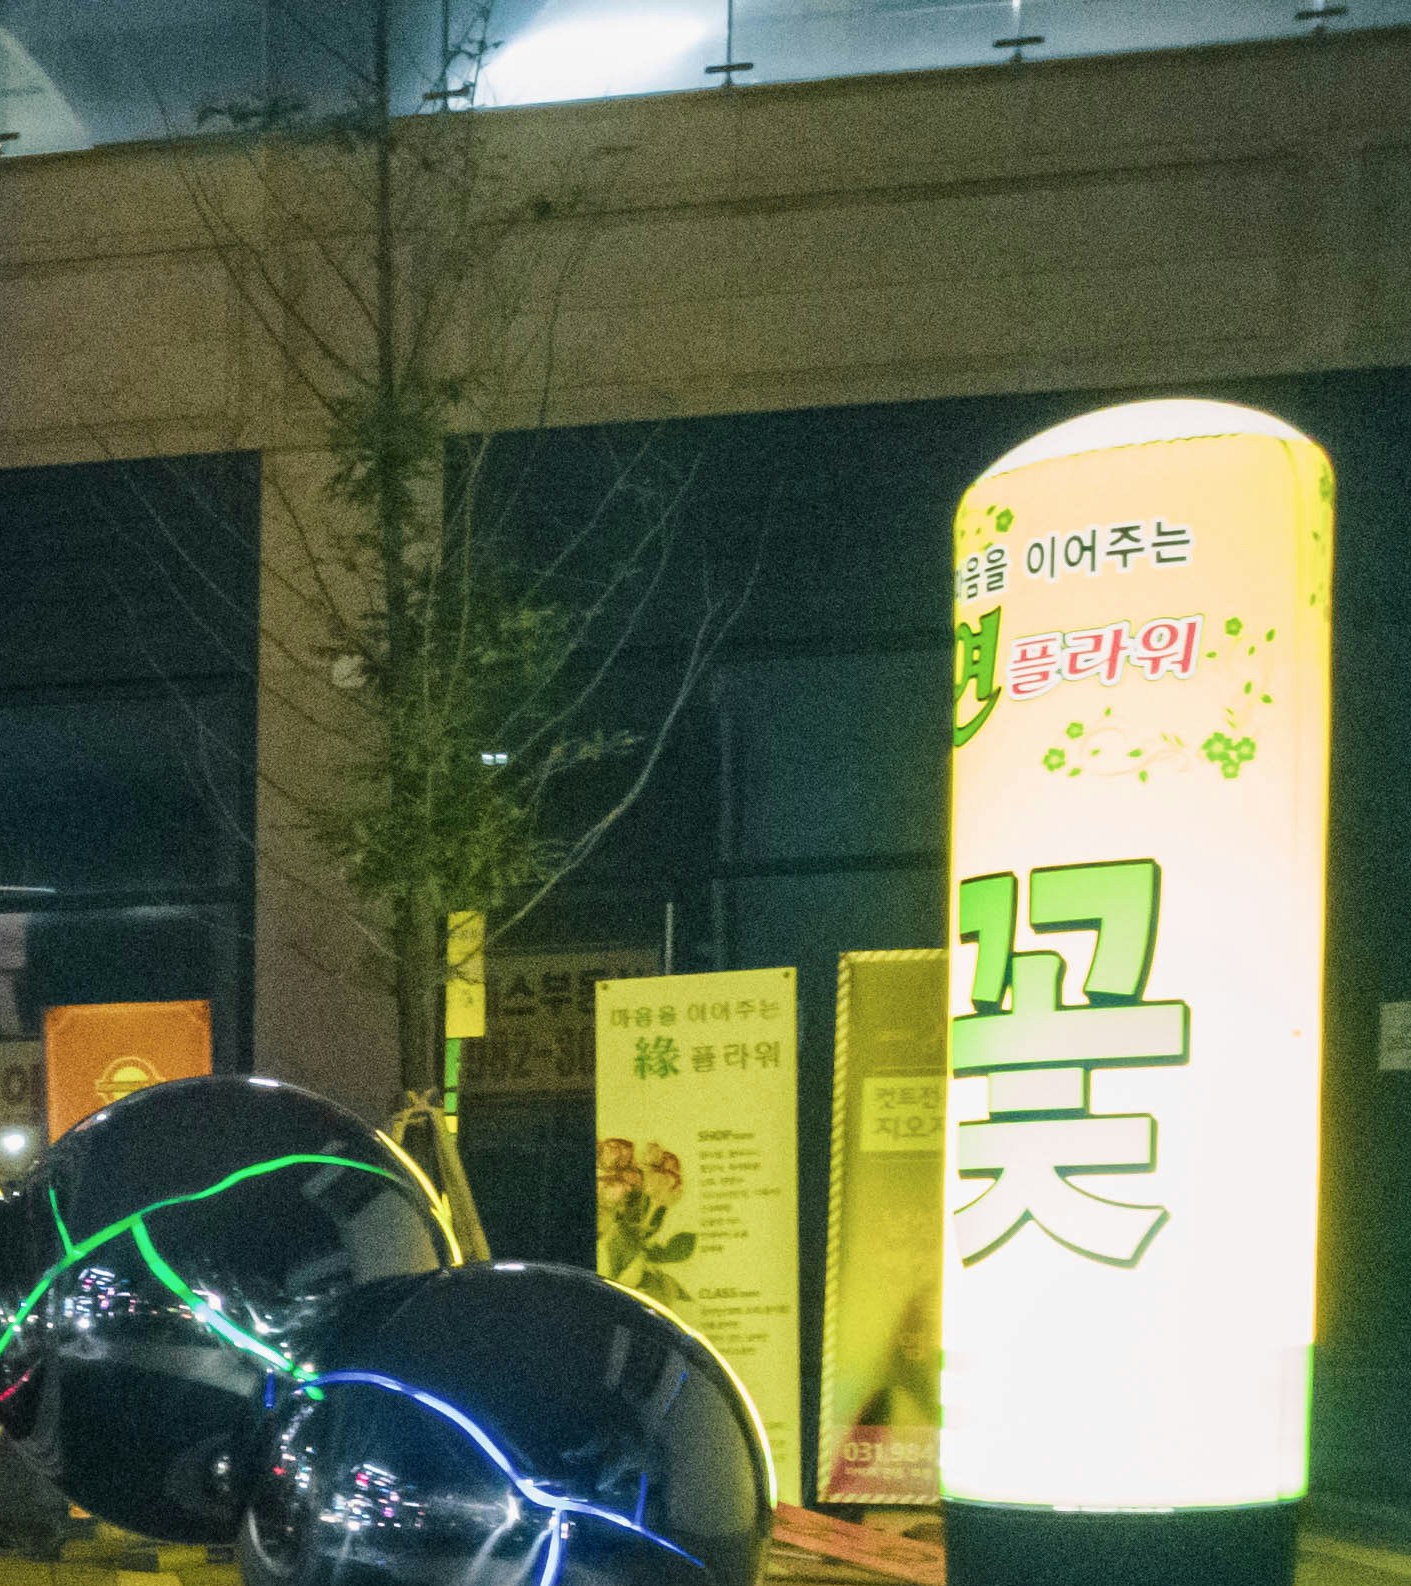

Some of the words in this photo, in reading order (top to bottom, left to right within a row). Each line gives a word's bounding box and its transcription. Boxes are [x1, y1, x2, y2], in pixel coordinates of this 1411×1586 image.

[956, 546, 1008, 600] 음을
[1026, 521, 1191, 579] 이어주는
[1011, 616, 1202, 698] 플라워
[610, 1004, 677, 1029] 마음을
[686, 999, 780, 1024] 이어주는
[690, 1040, 782, 1073] 플라워
[952, 857, 1191, 1268] 꽃
